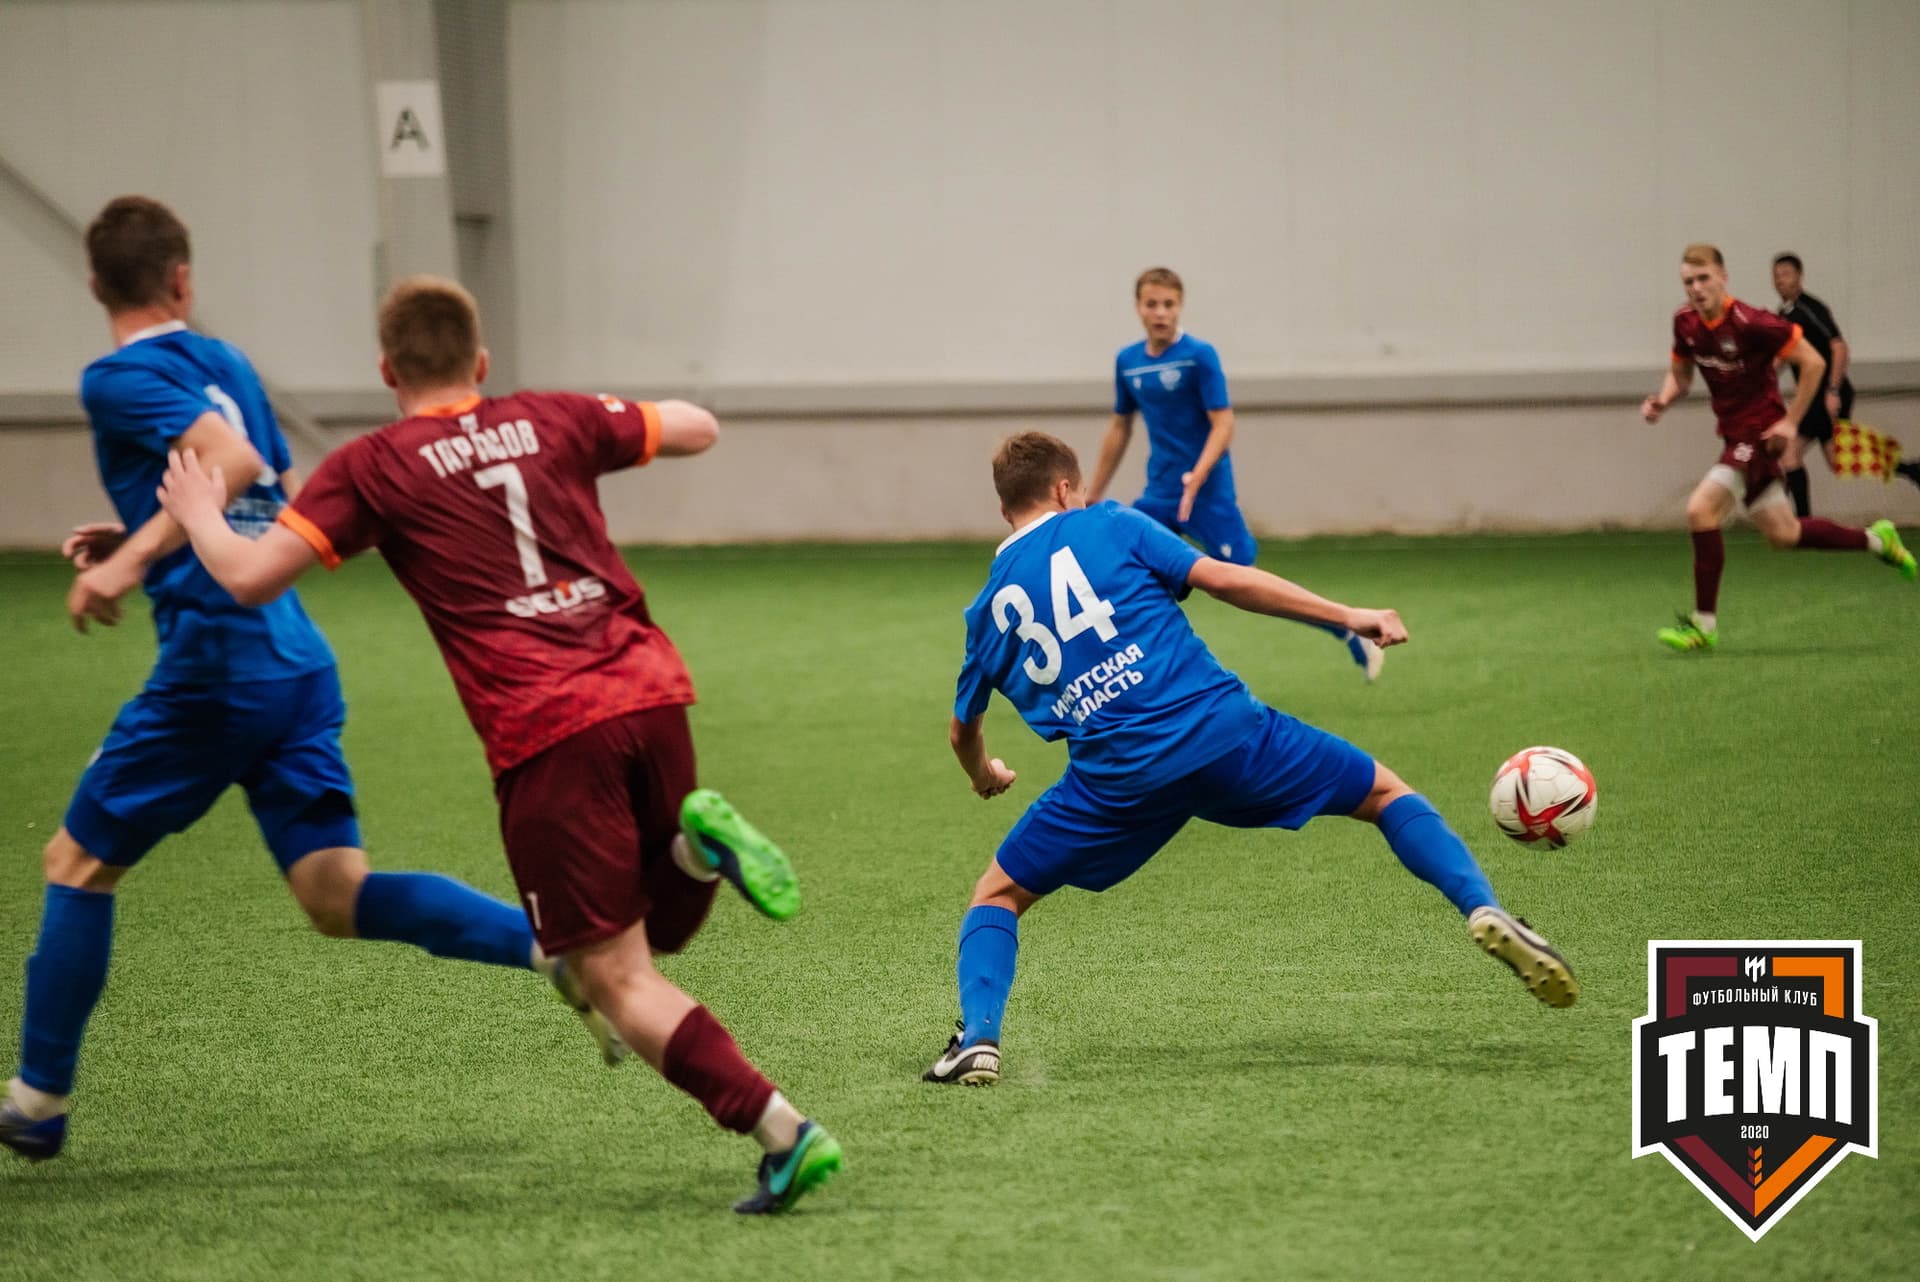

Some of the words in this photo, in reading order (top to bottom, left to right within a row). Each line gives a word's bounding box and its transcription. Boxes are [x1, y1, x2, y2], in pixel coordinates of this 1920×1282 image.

[473, 462, 547, 588] 7
[991, 545, 1119, 685] 34
[1051, 643, 1144, 719] ИУТСКАЯ
